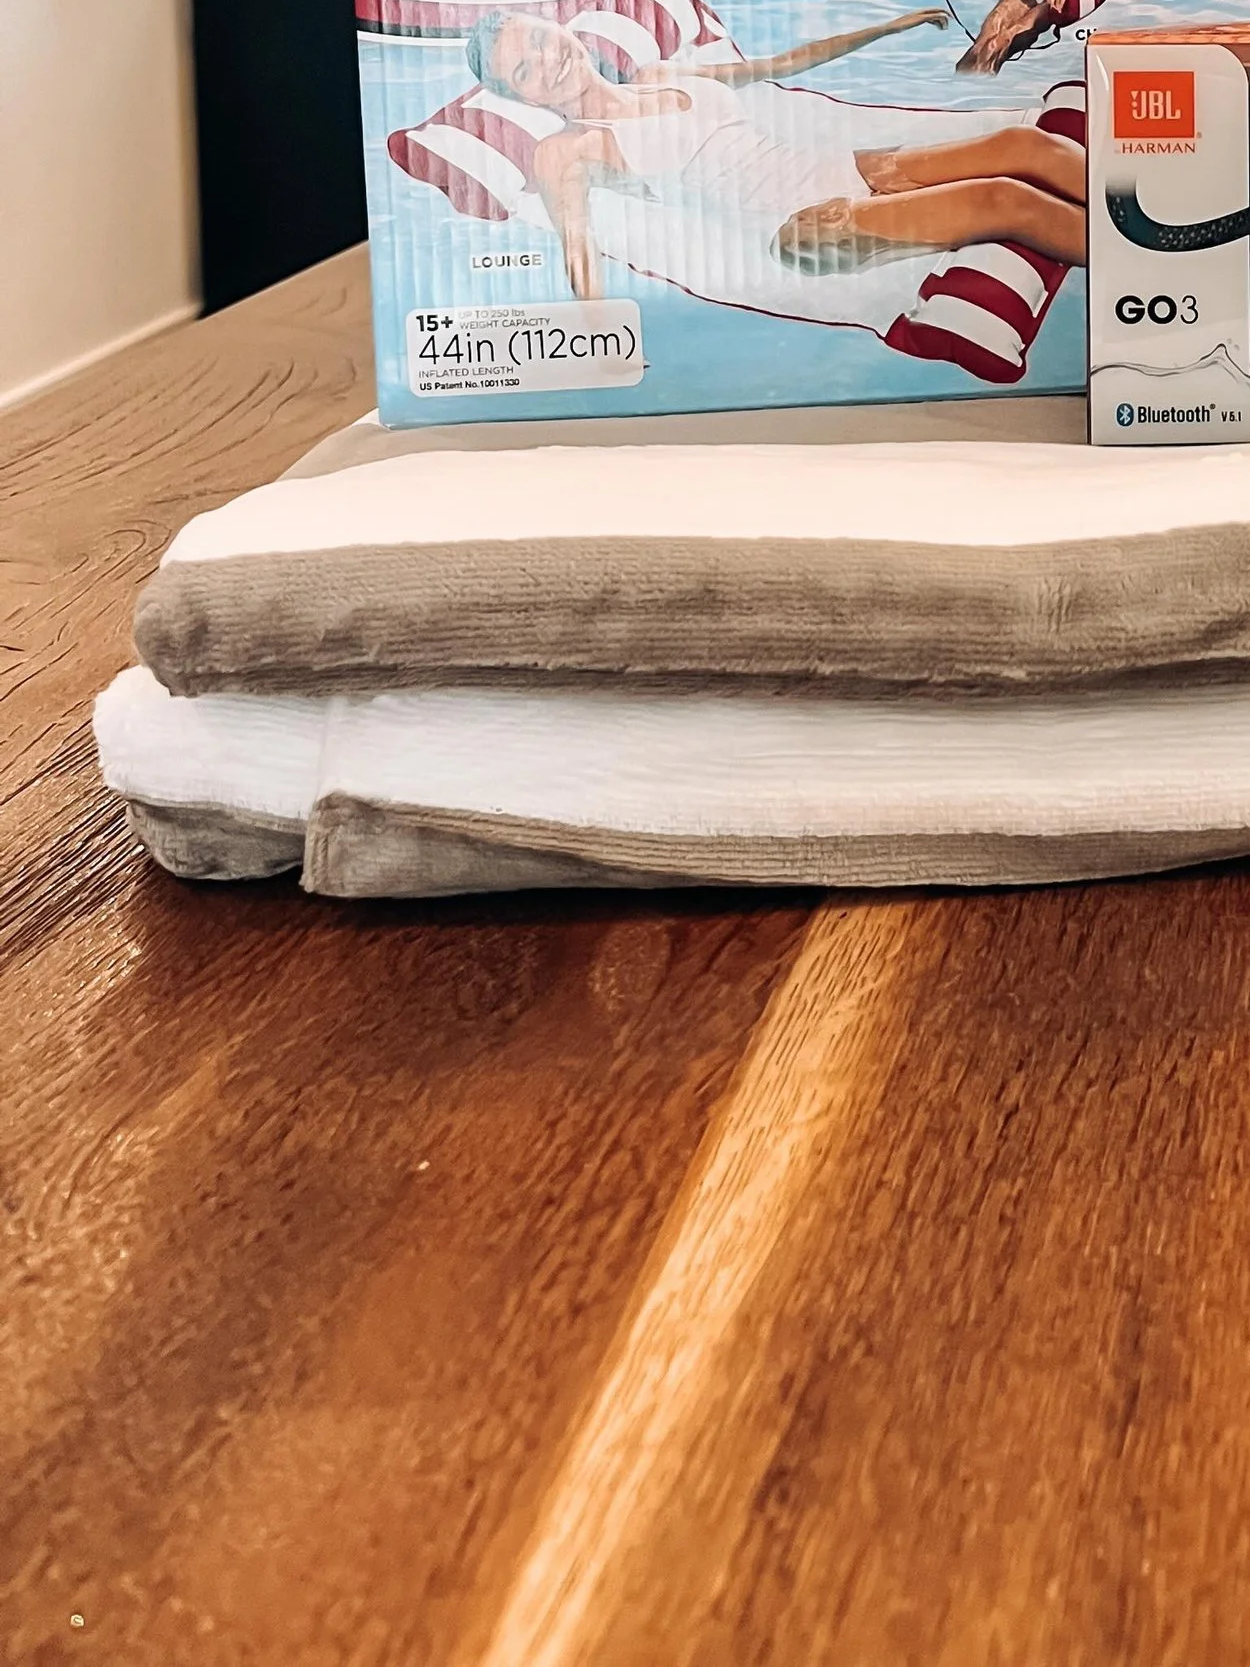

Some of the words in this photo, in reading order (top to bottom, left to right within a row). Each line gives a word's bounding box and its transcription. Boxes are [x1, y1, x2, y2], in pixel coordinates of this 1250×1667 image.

[1130, 90, 1182, 120] JBL
[1122, 142, 1196, 154] HARMAN
[472, 253, 543, 269] LOUNGE
[458, 310, 473, 319] UP
[475, 309, 489, 319] TO
[511, 307, 526, 318] lbs
[415, 314, 454, 333] 15+
[459, 320, 499, 330] WEIGHT
[501, 317, 551, 329] CAPACITY
[418, 332, 495, 366] 44in
[507, 325, 637, 366] (112cm)
[418, 368, 470, 378] INFLATED
[471, 366, 515, 376] LENGTH
[419, 382, 433, 391] US
[434, 381, 463, 391] Patent
